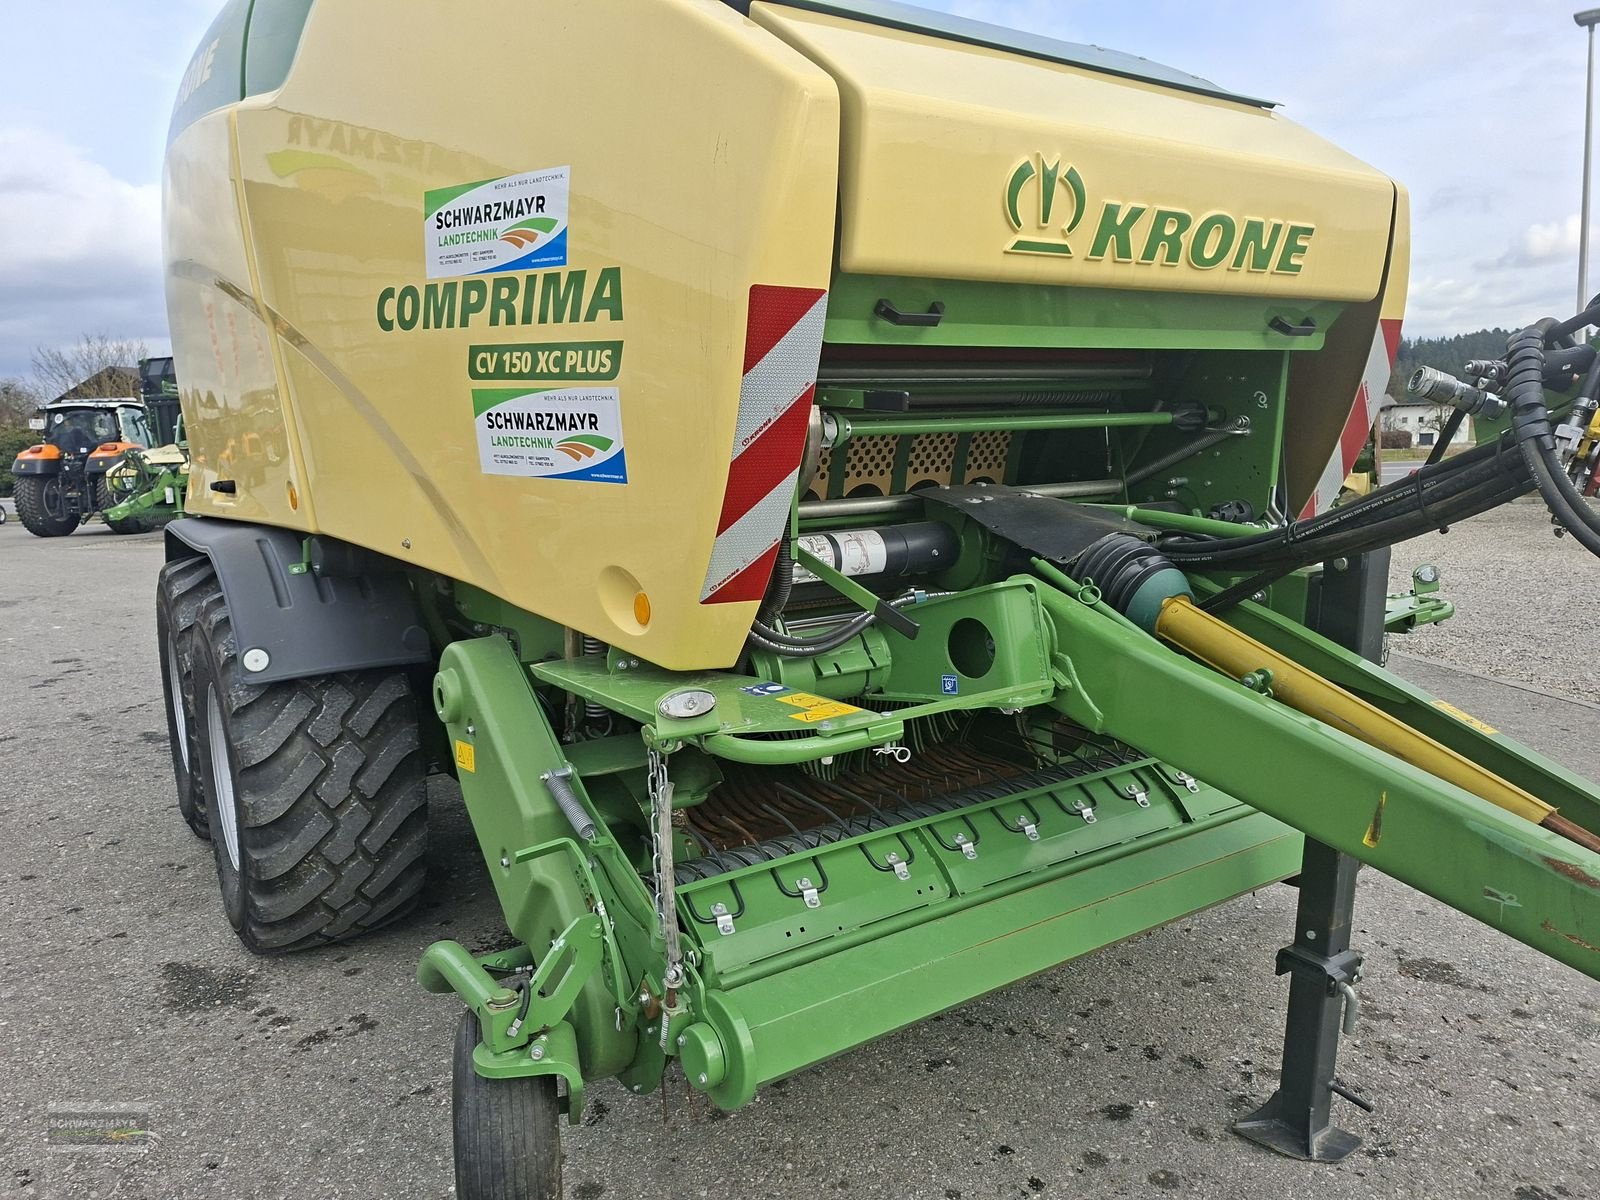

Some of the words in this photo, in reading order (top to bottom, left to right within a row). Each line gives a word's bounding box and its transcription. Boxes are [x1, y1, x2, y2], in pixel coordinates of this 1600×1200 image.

[436, 195, 546, 230] SCHWARZMAYR
[438, 228, 499, 247] LANDTECHNIK
[1086, 200, 1315, 275] KRONE
[376, 267, 624, 332] COMPRIMA
[476, 352, 498, 373] CV
[503, 351, 532, 373] 150
[536, 350, 561, 373] XC
[565, 349, 612, 373] PLUS
[486, 412, 599, 431] SCHWARZMAYR
[491, 435, 554, 449] LANDTECHNIK
